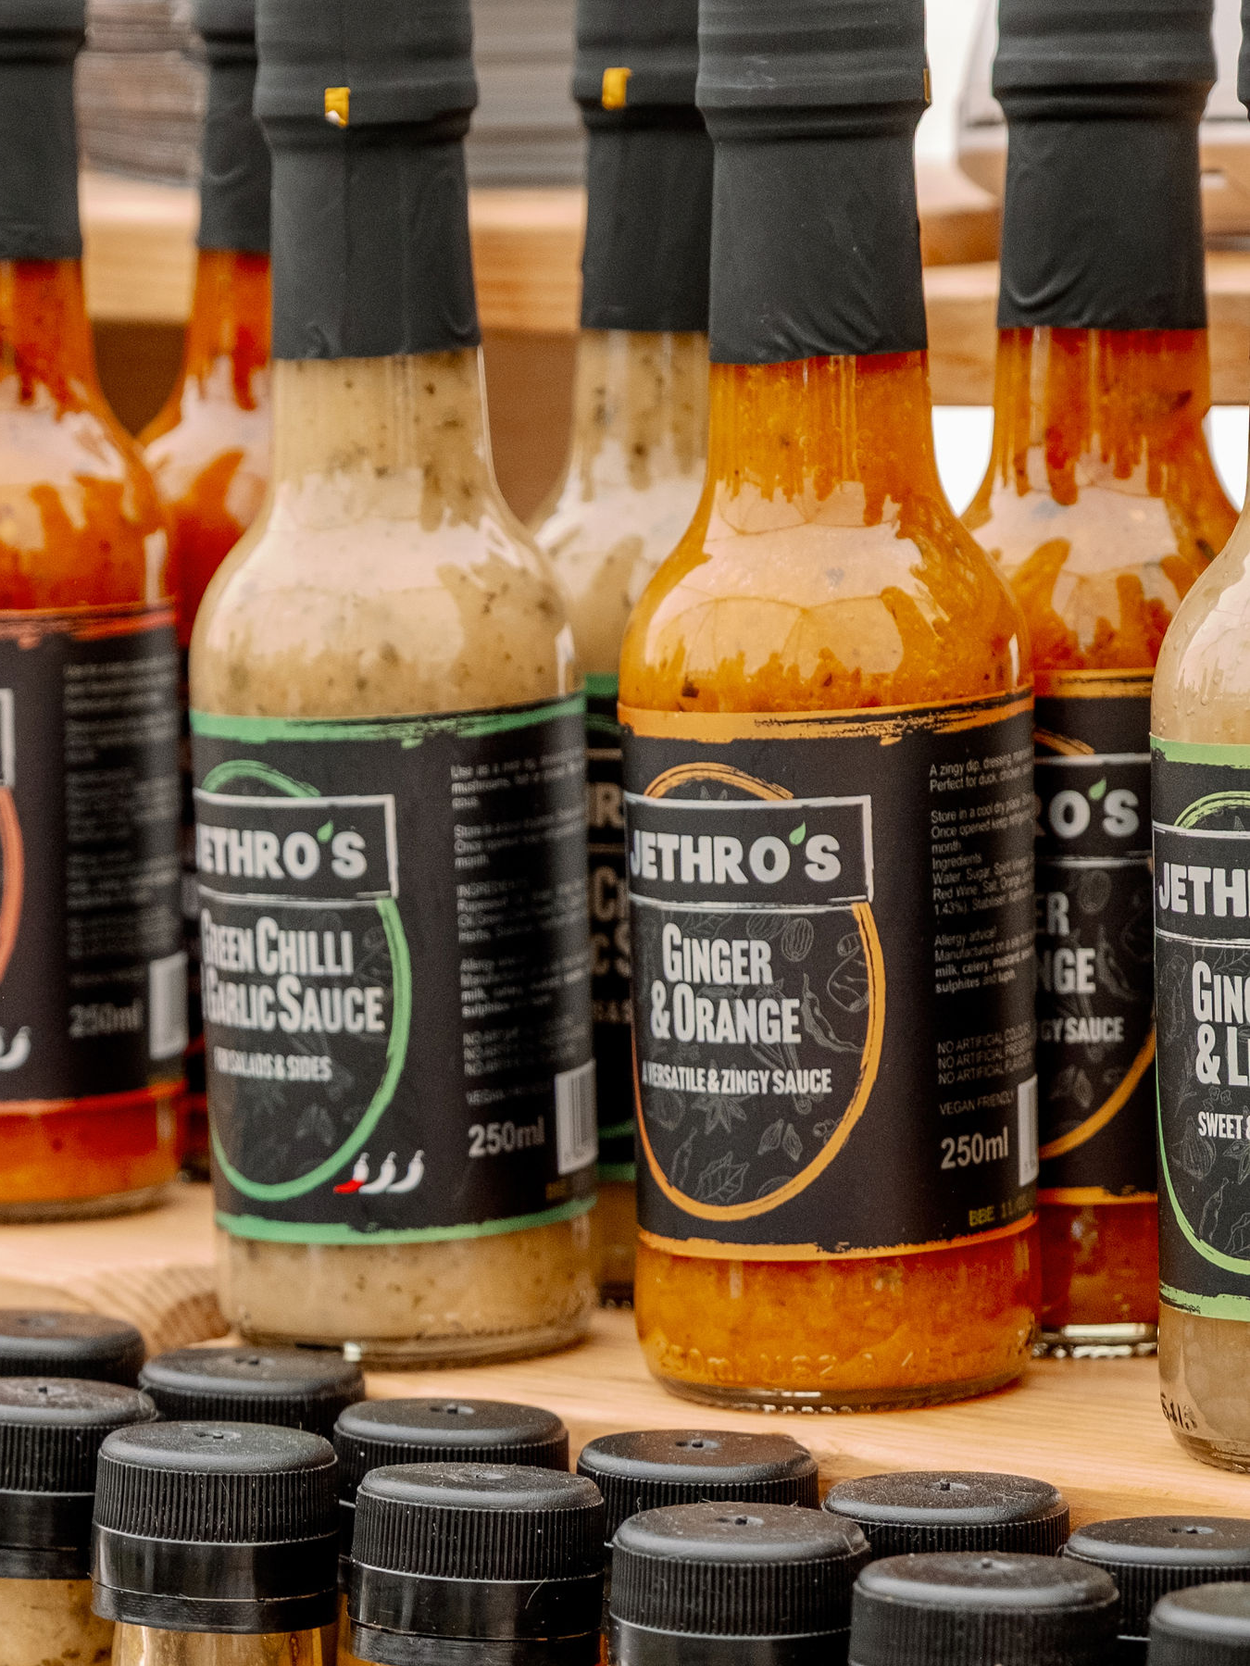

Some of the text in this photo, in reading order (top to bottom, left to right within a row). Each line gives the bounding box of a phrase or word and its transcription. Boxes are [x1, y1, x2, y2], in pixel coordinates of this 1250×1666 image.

[930, 776, 964, 792] Perfect
[940, 761, 964, 778] zingy
[931, 810, 957, 825] Store
[931, 826, 957, 839] Once
[197, 820, 368, 881] ETHRO'S
[630, 822, 841, 885] JETHRO'S
[256, 917, 353, 976] CHILLI
[662, 922, 773, 986] GINGER
[276, 973, 386, 1034] SAUCE
[673, 981, 802, 1045] ORANGE
[1064, 1016, 1125, 1044] SAUCE
[937, 1041, 954, 1055] NO
[938, 1056, 955, 1071] NO
[1196, 1023, 1221, 1086] &
[286, 1054, 333, 1082] SIDES
[648, 1061, 706, 1093] VERSATILE
[721, 1068, 770, 1095] ZINGY
[772, 1068, 832, 1095] SAUCE
[938, 1071, 955, 1086] NO
[468, 1114, 545, 1158] 250ml
[1198, 1111, 1244, 1139] SWEET
[940, 1125, 1008, 1170] 250ml
